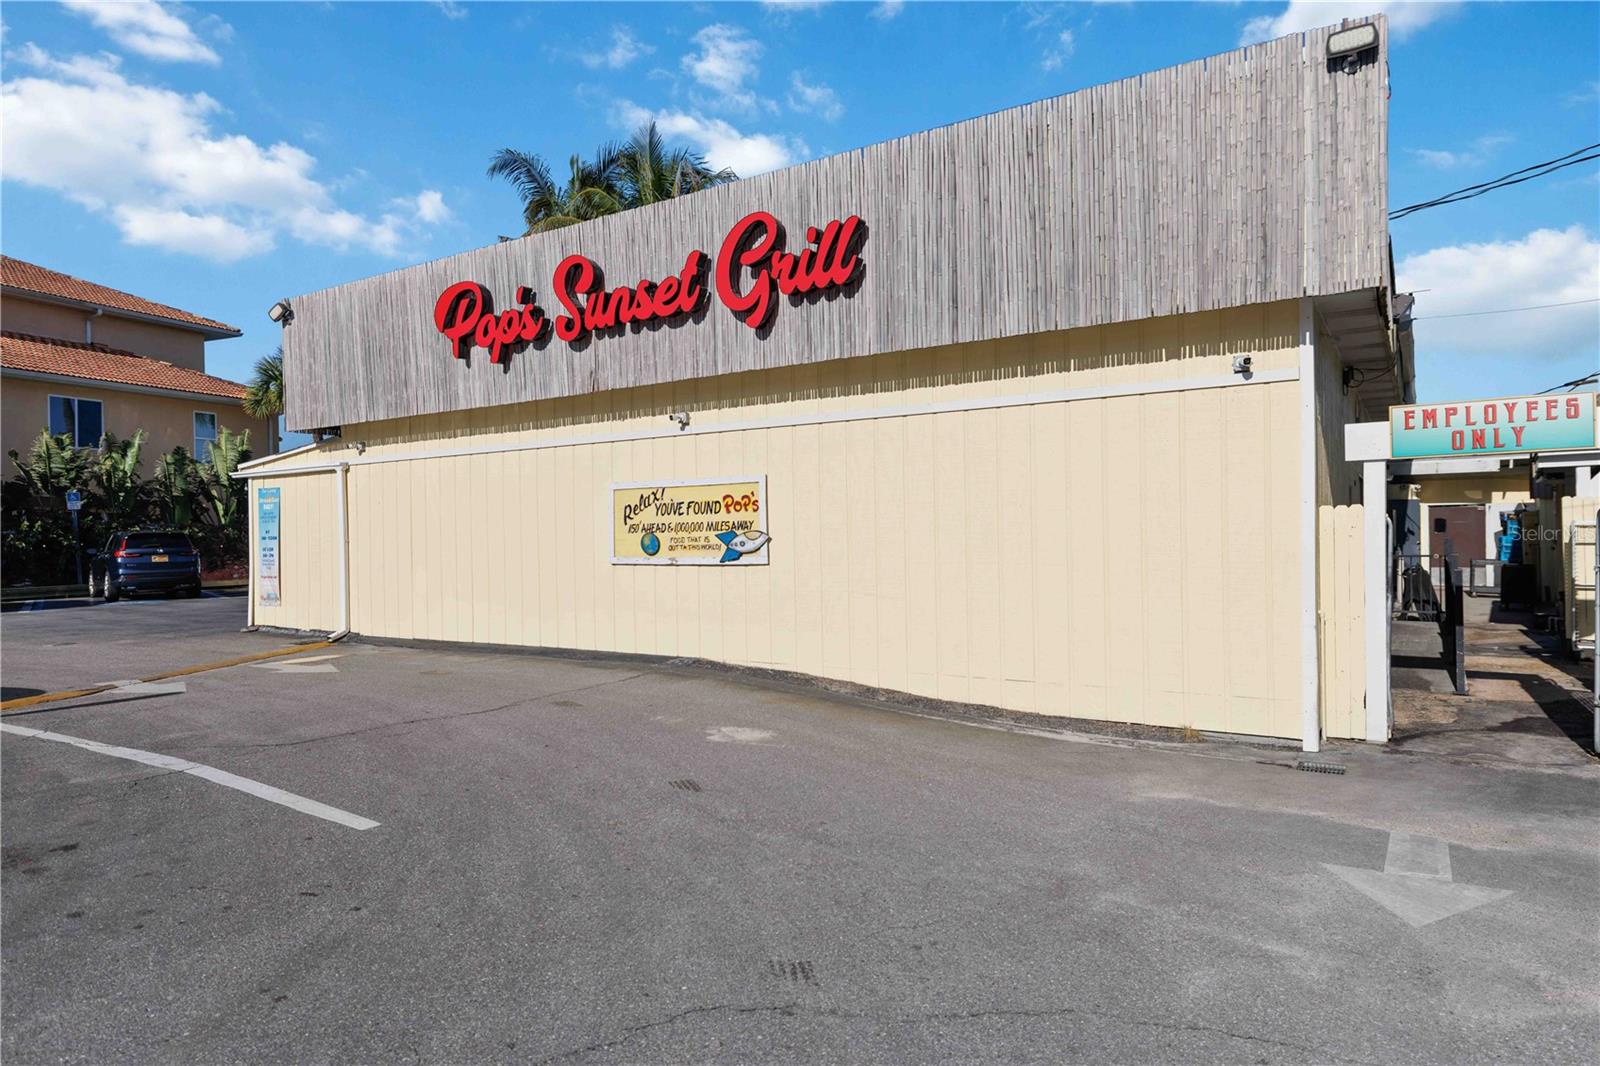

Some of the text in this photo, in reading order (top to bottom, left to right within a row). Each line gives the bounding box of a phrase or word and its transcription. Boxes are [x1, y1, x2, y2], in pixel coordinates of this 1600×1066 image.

[434, 211, 860, 364] Pop's Sunset Grill
[1404, 397, 1581, 431] EMPLOYEES
[1452, 426, 1525, 450] ONLY
[623, 487, 665, 526] Relax!
[654, 498, 685, 517] YOU'VE
[686, 500, 722, 516] FOUND
[641, 522, 667, 534] AHEAD
[667, 522, 674, 533] &
[705, 520, 730, 532] MILES
[730, 519, 754, 531] AWAY
[704, 535, 711, 543] IS
